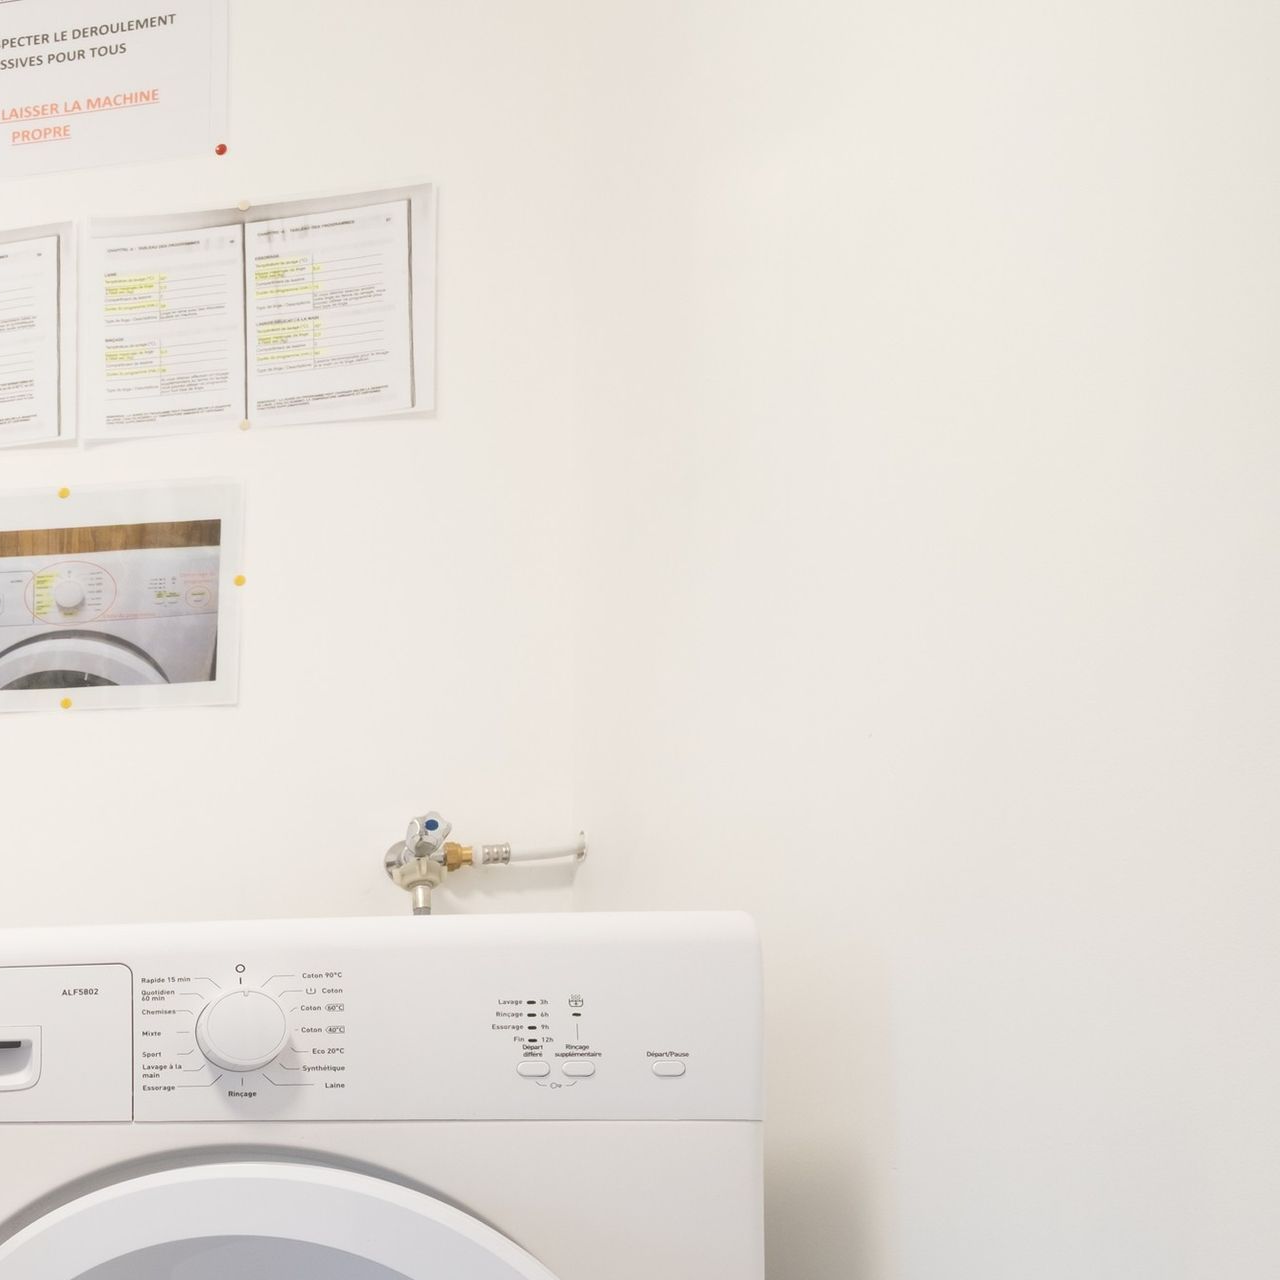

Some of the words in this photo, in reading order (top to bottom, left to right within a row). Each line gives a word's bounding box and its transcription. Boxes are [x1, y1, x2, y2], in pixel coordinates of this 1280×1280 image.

[54, 30, 68, 42] LE
[72, 13, 176, 40] DEROULEMENT
[47, 49, 86, 64] POUR
[90, 43, 127, 58] TOUS
[1, 102, 60, 121] LAISSER
[64, 99, 83, 113] LA
[86, 88, 160, 110] MACHINE
[11, 124, 71, 143] PROPRE
[62, 988, 99, 996] ALF5802
[302, 1065, 345, 1073] Synthétique
